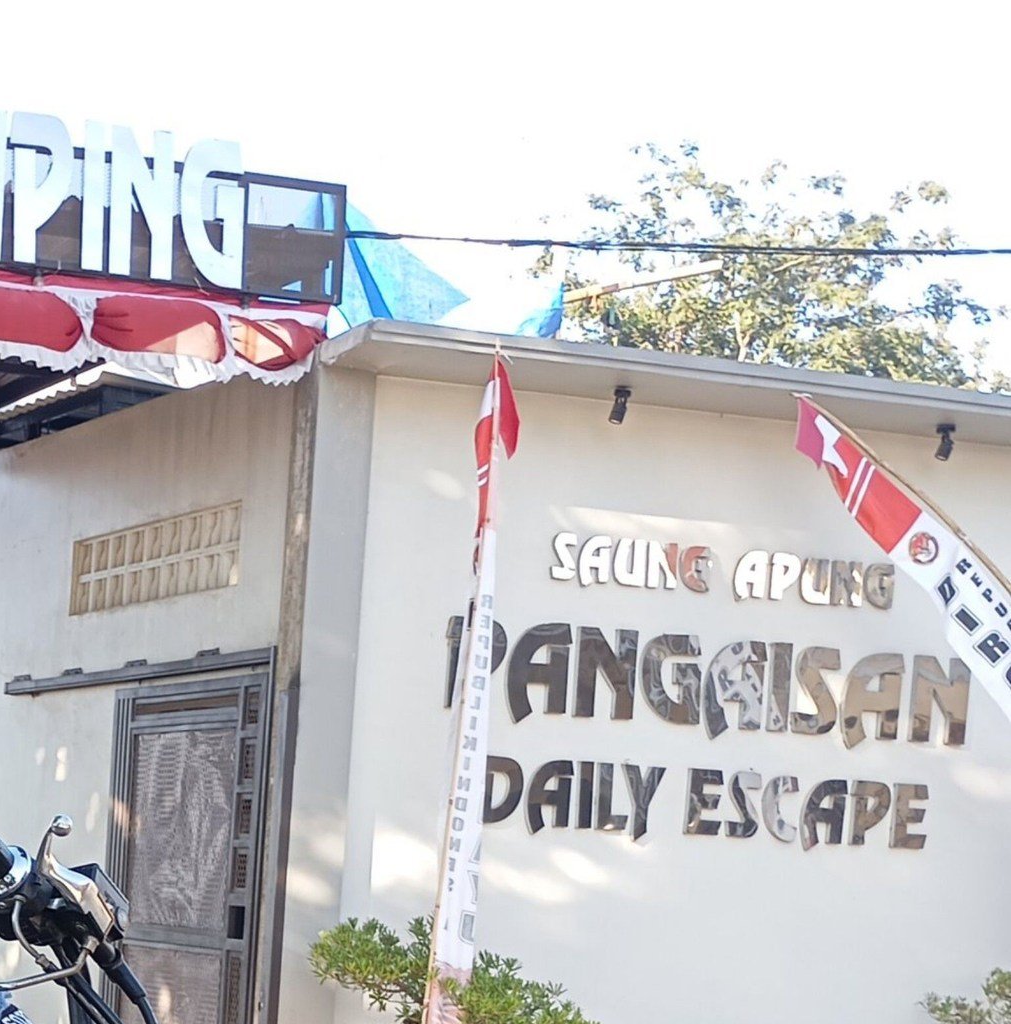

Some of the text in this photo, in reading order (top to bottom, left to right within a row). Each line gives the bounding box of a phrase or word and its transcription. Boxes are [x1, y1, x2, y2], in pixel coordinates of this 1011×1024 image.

[549, 532, 895, 611] SAUNG APUNG
[483, 755, 929, 852] DAILY ESCAPE
